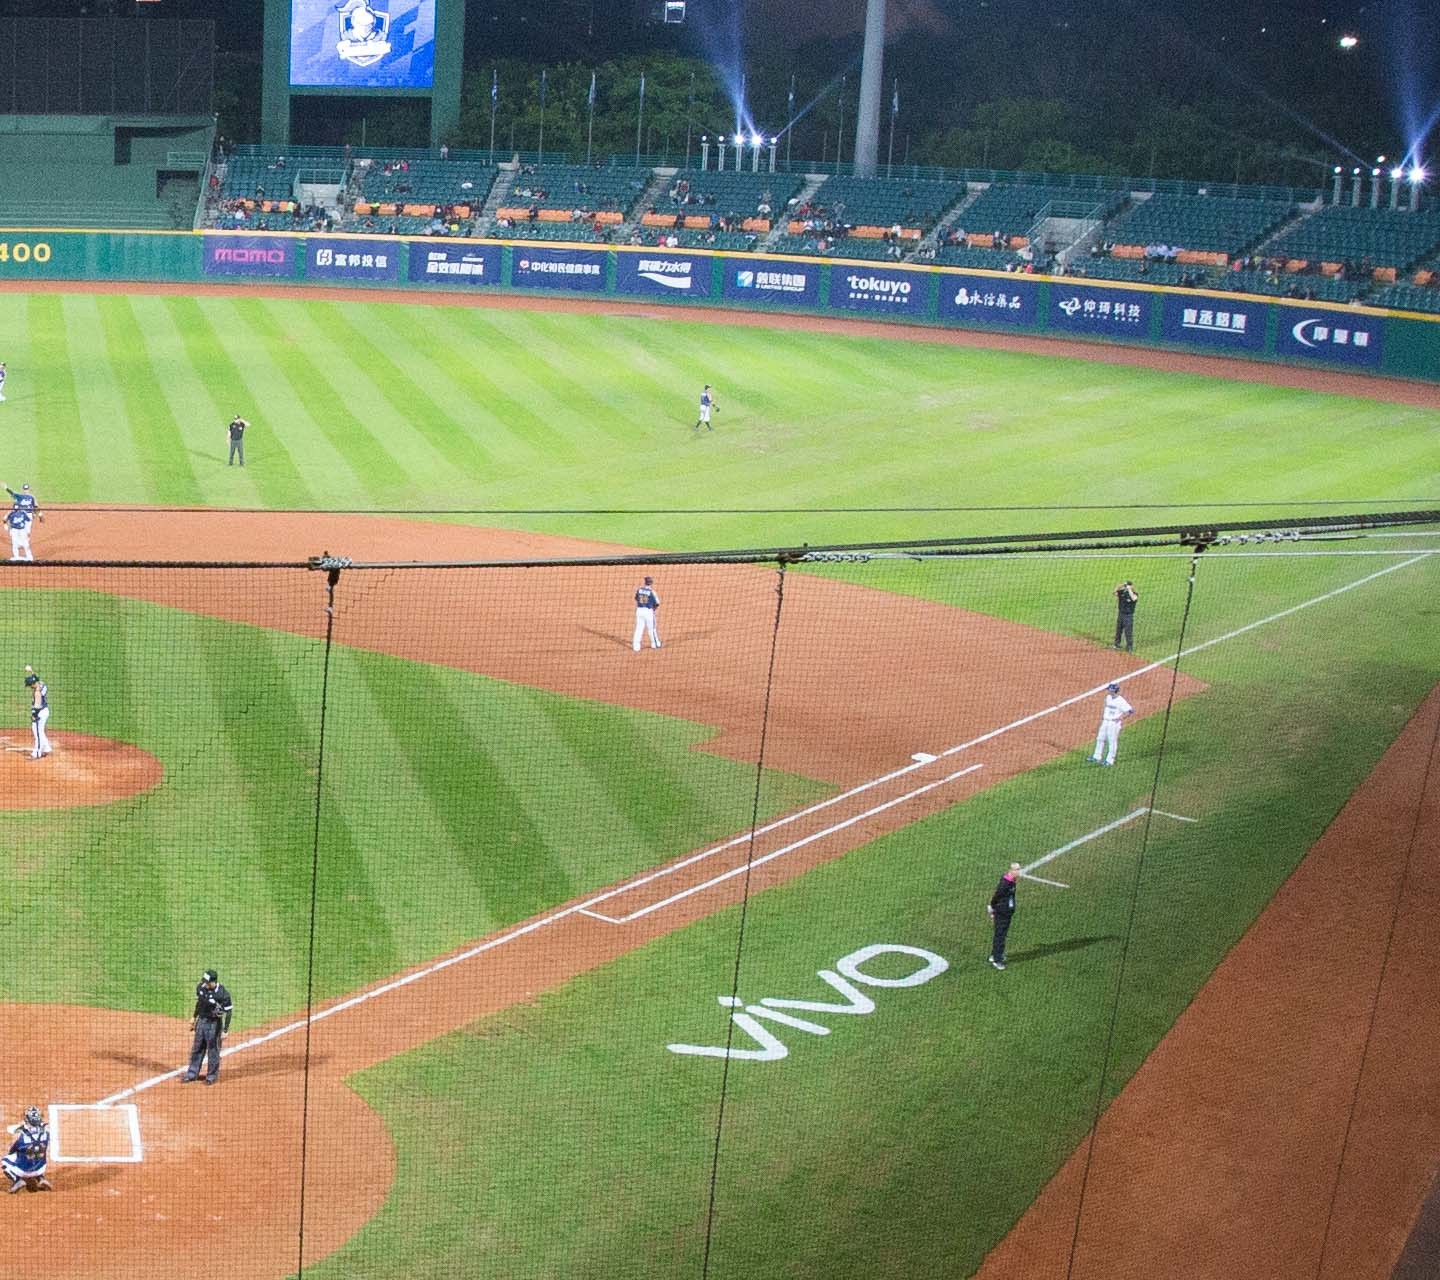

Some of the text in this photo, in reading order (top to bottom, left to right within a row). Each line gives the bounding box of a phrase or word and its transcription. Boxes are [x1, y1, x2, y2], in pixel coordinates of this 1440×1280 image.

[214, 247, 285, 264] momo
[335, 254, 387, 269] 富邦投信
[848, 275, 911, 295] tokuyo
